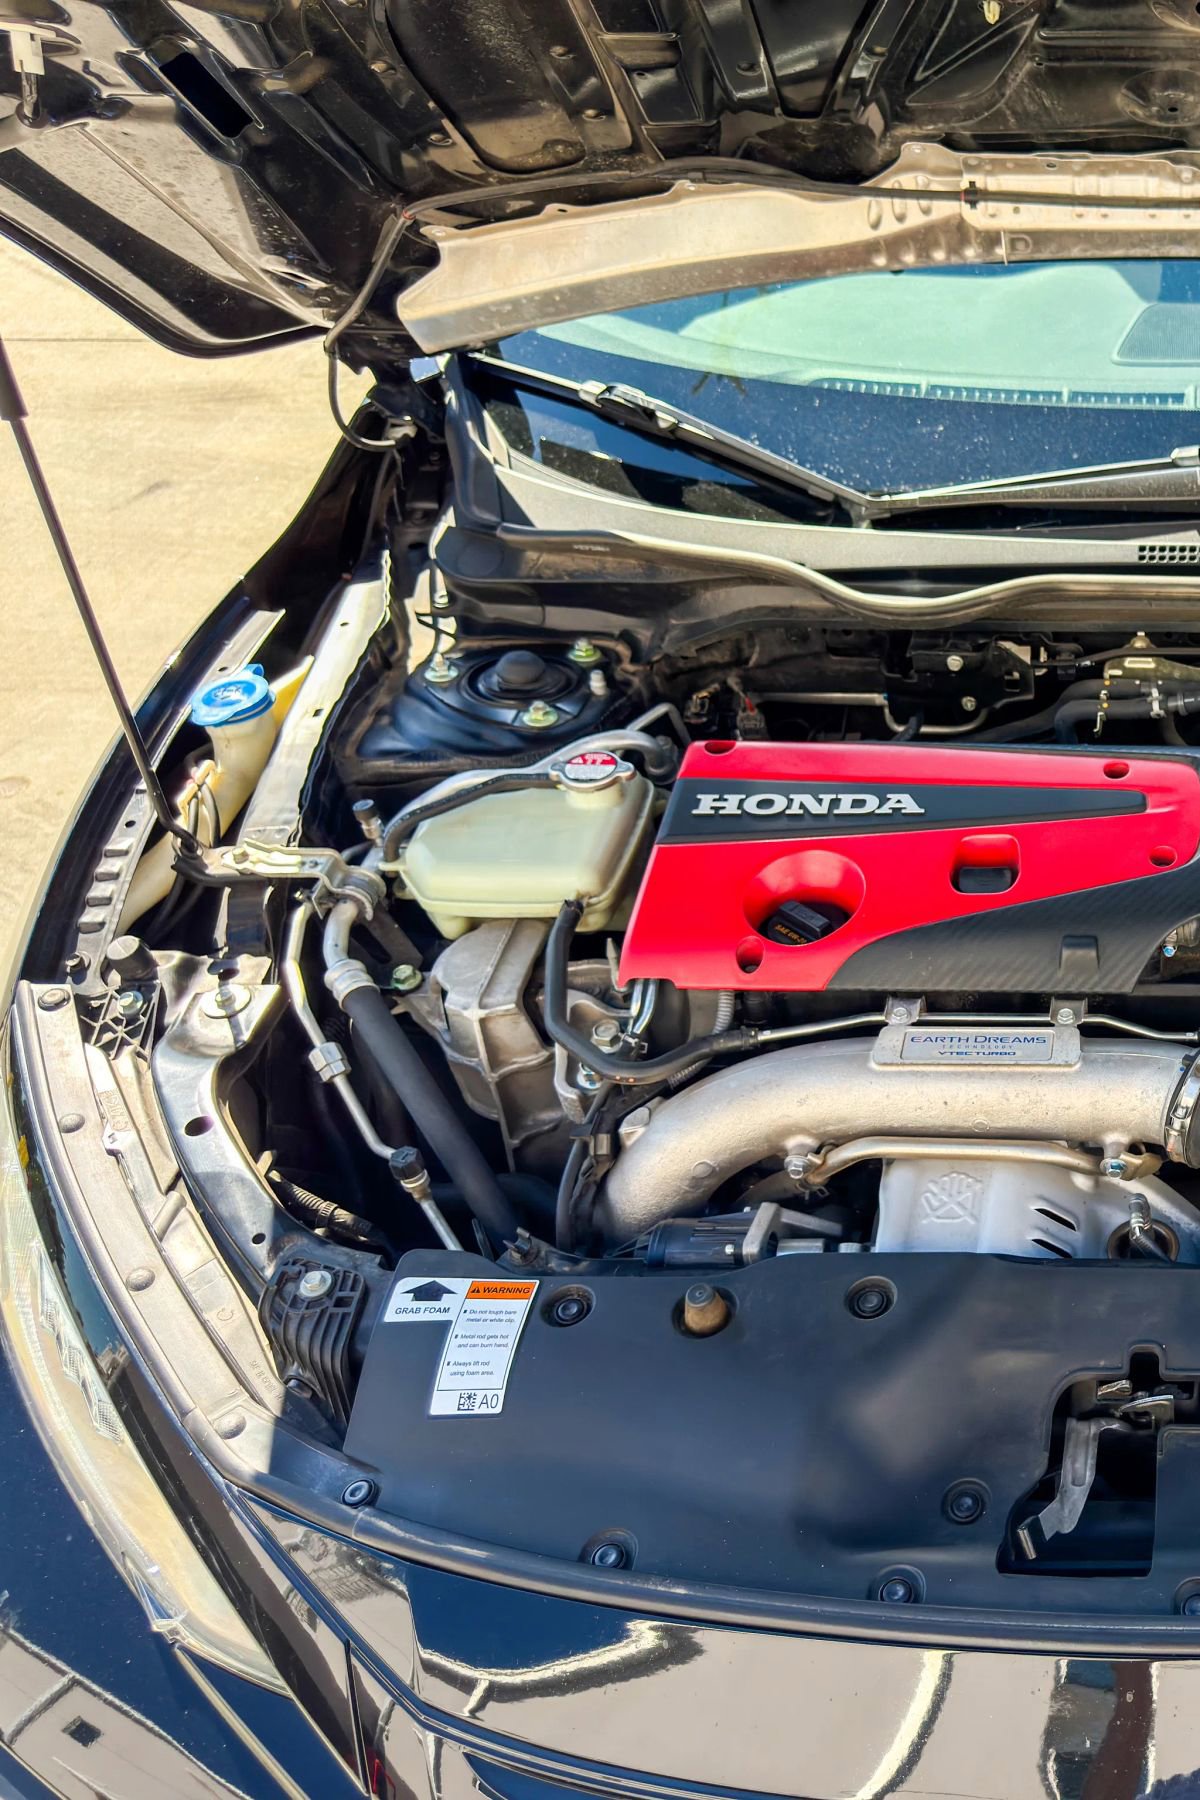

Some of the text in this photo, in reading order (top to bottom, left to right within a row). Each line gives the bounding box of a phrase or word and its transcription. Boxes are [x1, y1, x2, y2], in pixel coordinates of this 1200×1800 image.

[691, 793, 926, 816] HONDA
[910, 1035, 1047, 1044] EARTH DREAMS
[483, 1286, 531, 1294] WARNING
[395, 1306, 450, 1315] GRAB FOAM
[478, 1393, 499, 1409] A0
